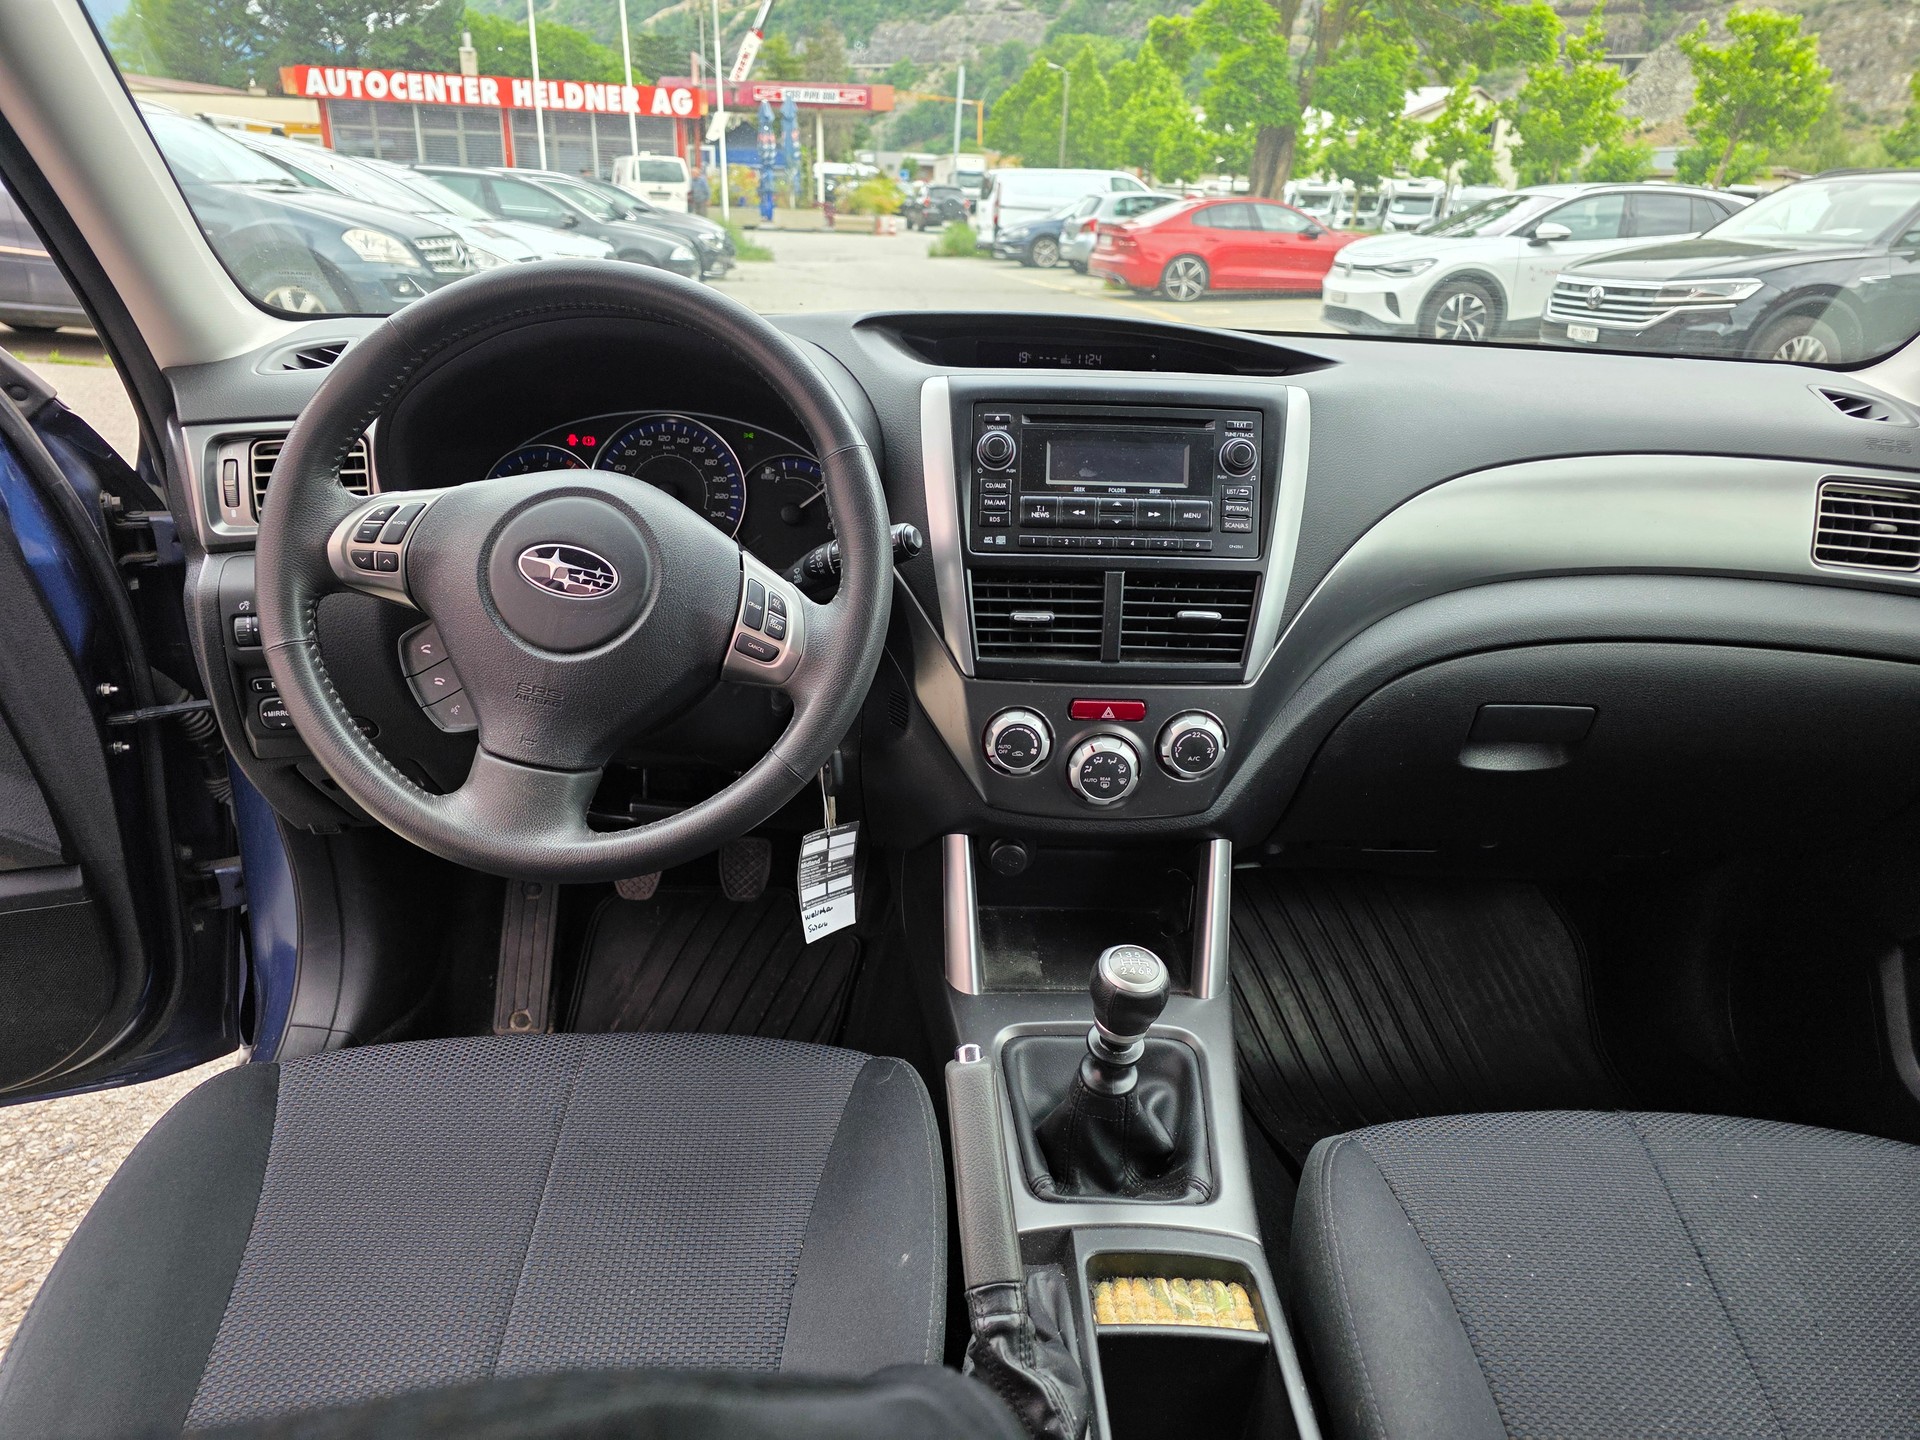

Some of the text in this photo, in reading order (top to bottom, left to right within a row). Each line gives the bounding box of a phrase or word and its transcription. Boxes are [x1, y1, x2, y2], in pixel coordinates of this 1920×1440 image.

[305, 67, 694, 115] AUTOCENTER HELDNER AG
[658, 434, 671, 442] 120
[676, 436, 690, 444] 140
[639, 439, 653, 447] 100
[624, 449, 637, 457] 80
[692, 446, 706, 454] 160
[704, 458, 718, 467] 180
[522, 464, 529, 472] 3
[614, 464, 627, 472] 60
[712, 475, 728, 483] 200
[774, 475, 781, 484] F
[714, 492, 729, 500] 220
[1194, 541, 1201, 549] 6
[747, 642, 765, 654] CANCEL
[1120, 967, 1153, 975] 2 4 6 R
